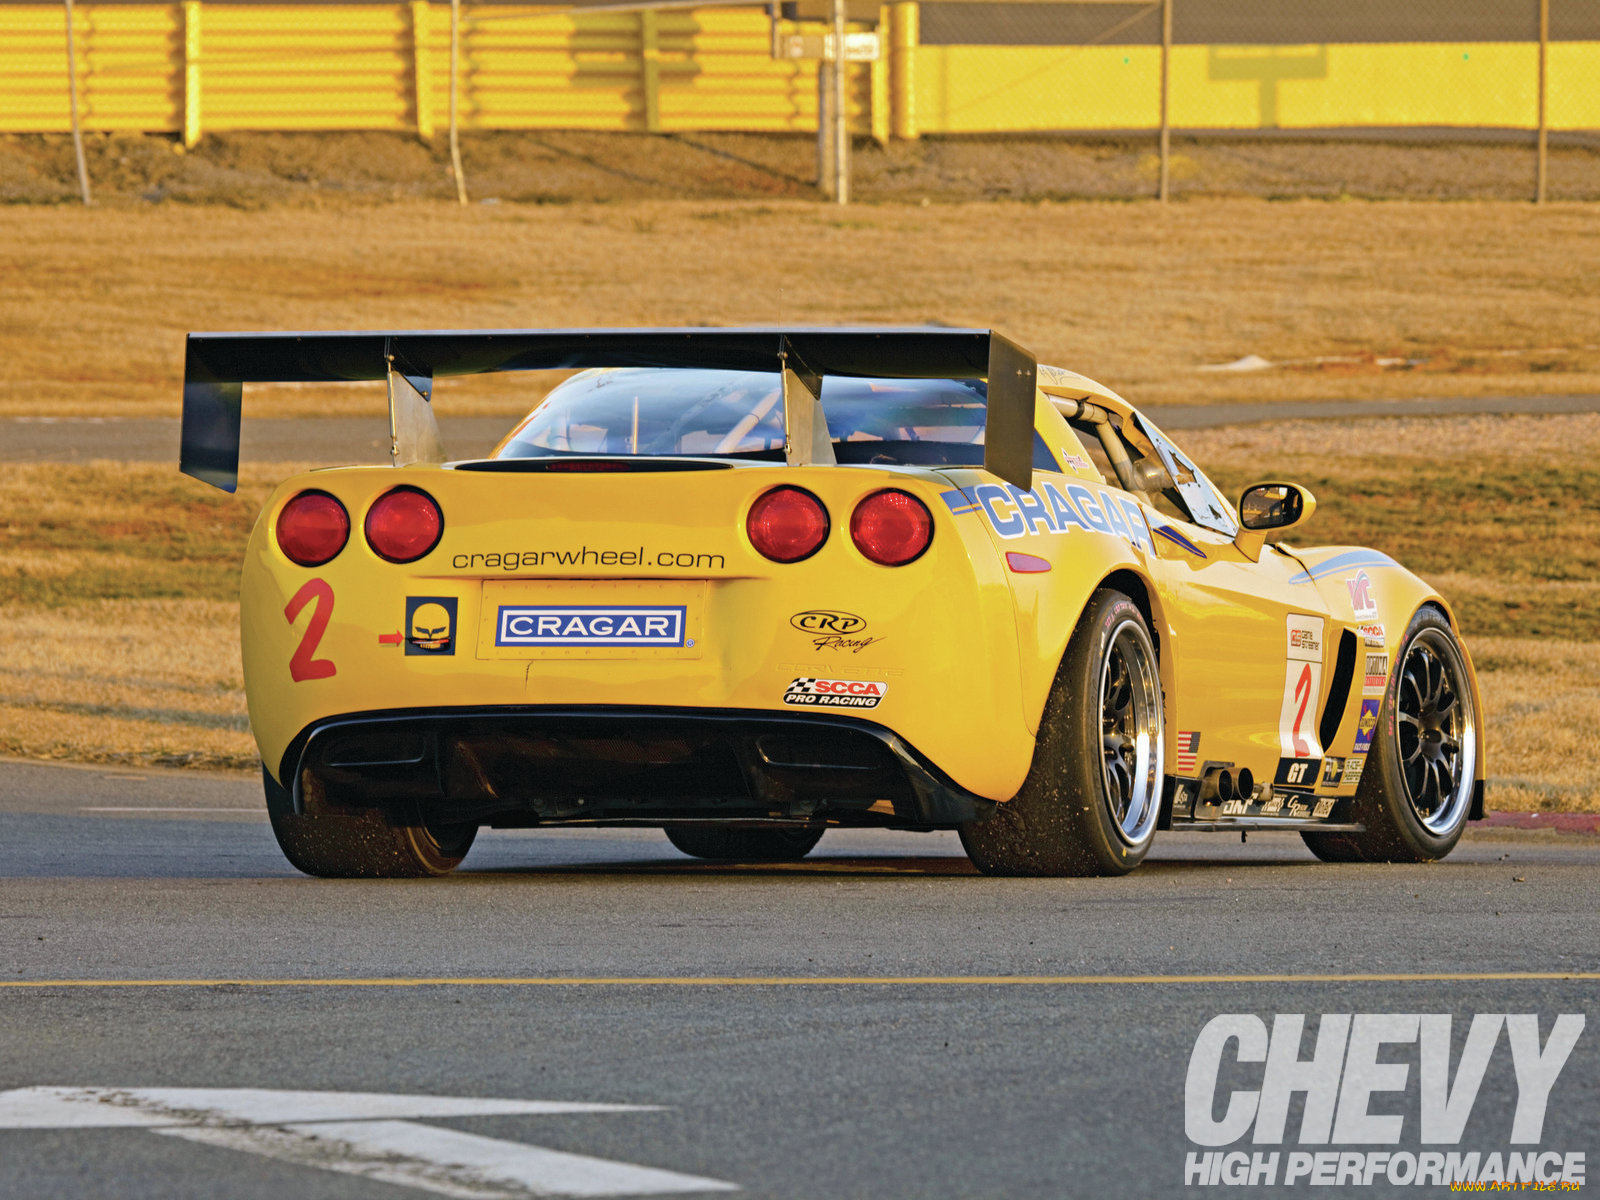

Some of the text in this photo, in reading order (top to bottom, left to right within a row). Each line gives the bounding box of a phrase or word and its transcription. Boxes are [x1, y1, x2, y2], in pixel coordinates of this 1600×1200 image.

[974, 481, 1157, 560] CRAGAR
[452, 546, 726, 571] cragarwheel.com
[284, 577, 337, 683] 2
[509, 616, 670, 636] CRAGAR
[798, 611, 861, 635] CRP
[813, 635, 888, 654] Racing
[815, 680, 881, 696] SCCA
[785, 694, 877, 707] PRO RACING
[1293, 663, 1312, 758] 2
[1286, 762, 1309, 784] GT
